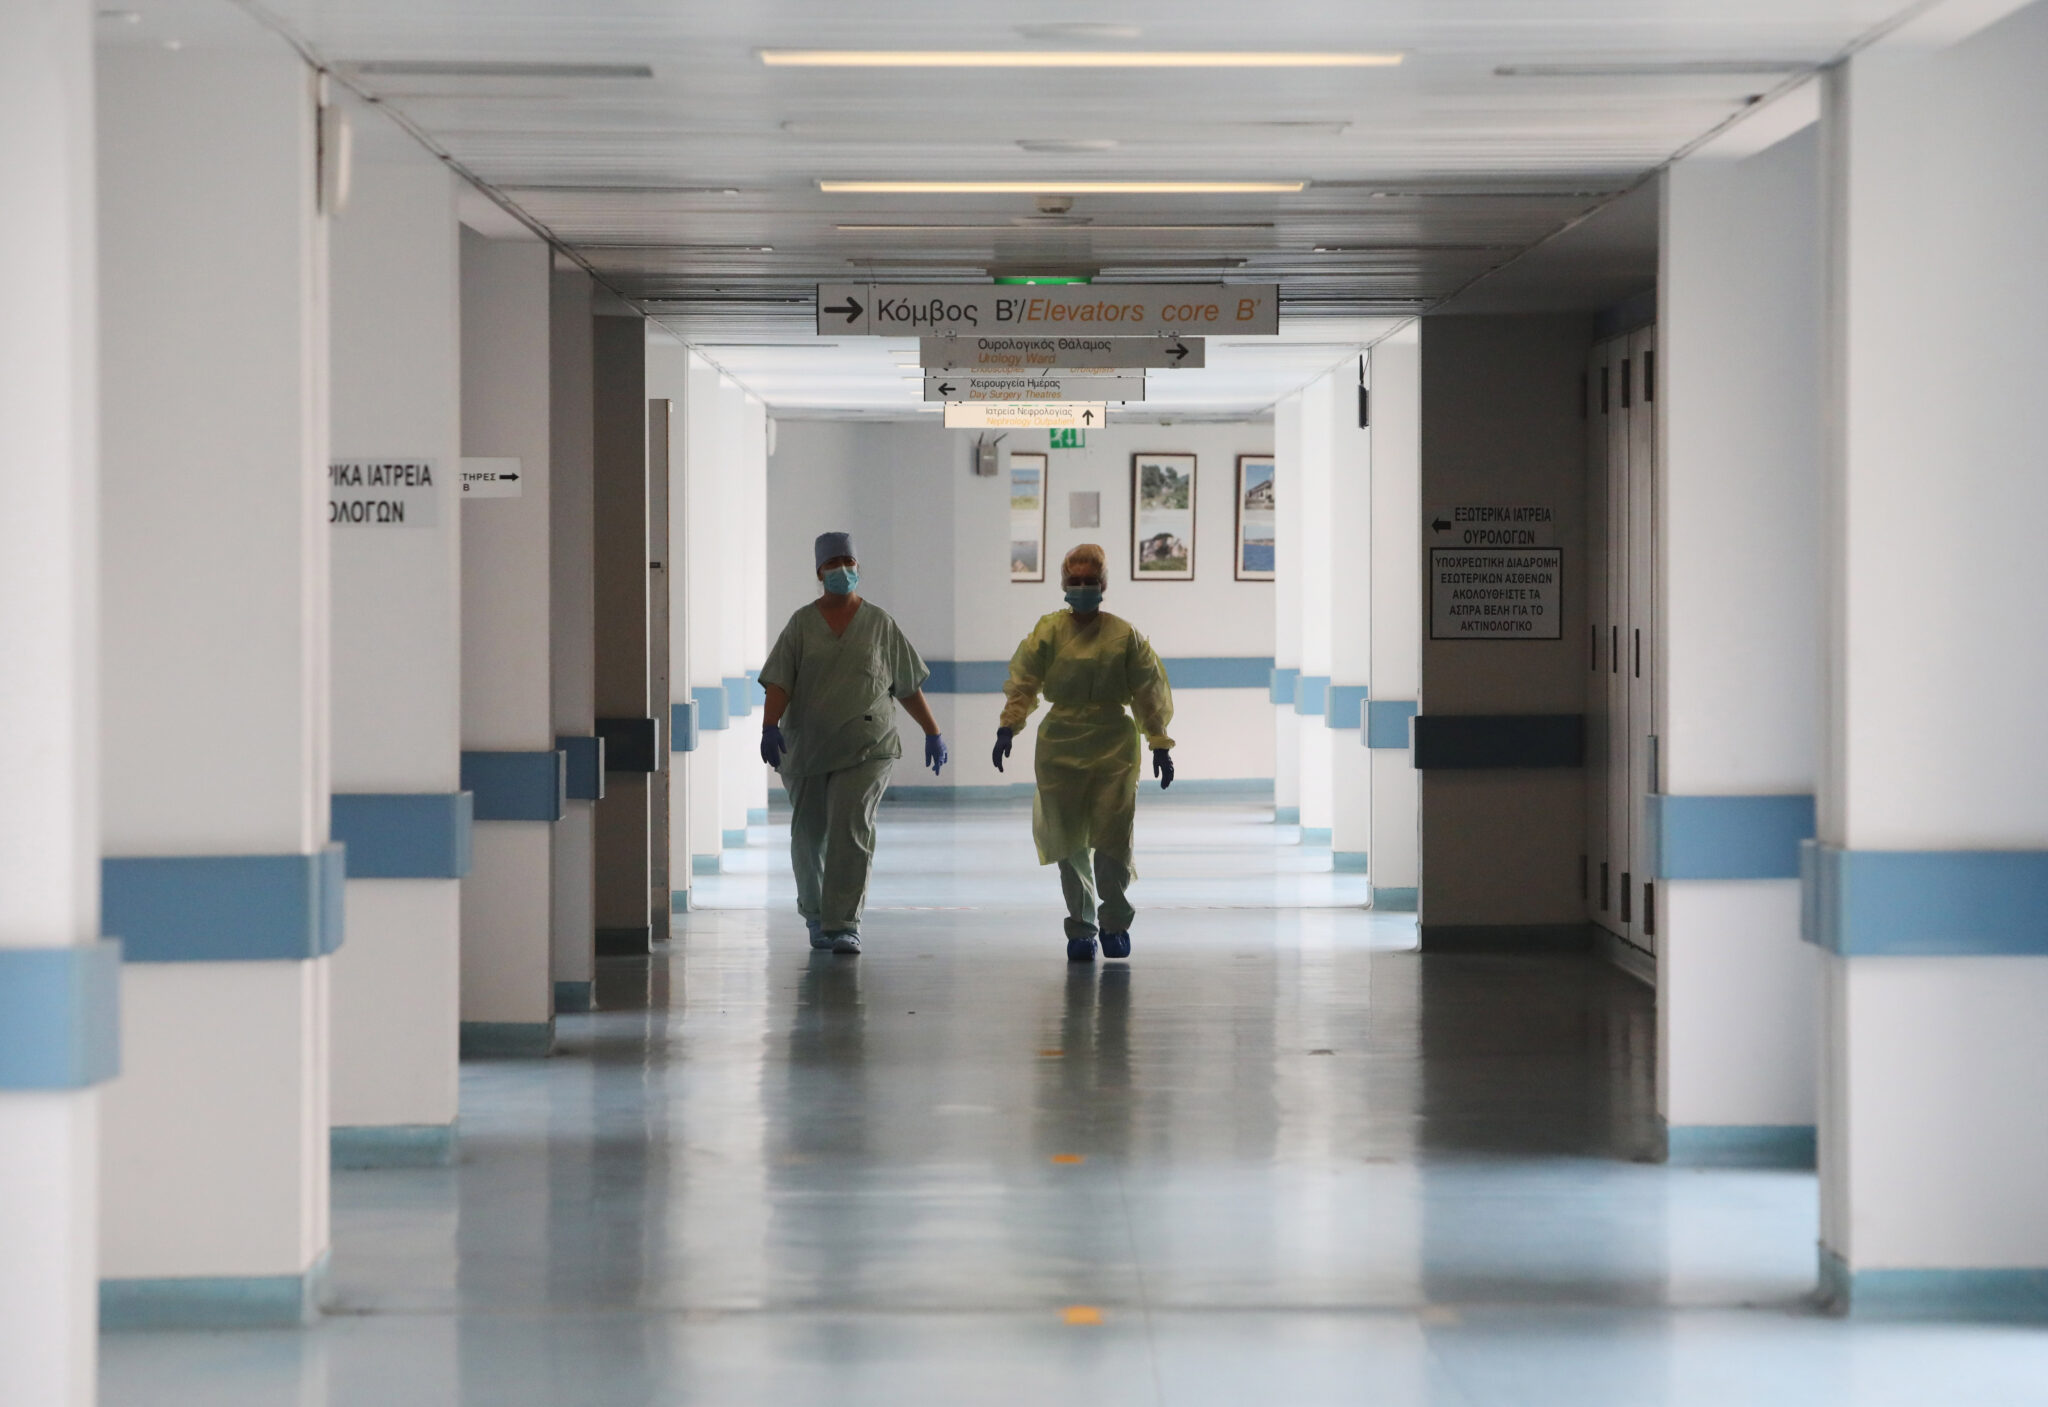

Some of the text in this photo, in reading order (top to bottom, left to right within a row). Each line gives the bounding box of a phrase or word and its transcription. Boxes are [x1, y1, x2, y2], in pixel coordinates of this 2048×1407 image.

[878, 298, 978, 327] Κόμβος
[1161, 303, 1220, 322] core
[978, 338, 1112, 352] Ουρολογικός Θάλαμος
[978, 352, 1057, 366] Urology Ward
[970, 378, 1061, 389] Χειρουργεία Ημέρας
[969, 390, 1062, 400] Day Surgery Theatres
[985, 407, 1015, 416] Ιατρεία
[367, 464, 433, 487] ΙΑΤΡΕΙΑ
[1455, 507, 1552, 522] ΕΞΩΤΕΡΙΚΑ ΙΑΤΡΕΙΑ
[1463, 530, 1535, 544] ΟΥΡΟΛΟΓΩΝ
[1435, 557, 1558, 568] ΥΠΟΧΡΕΩΤΙΚΗ ΔΙΑΔΡΟΜΗ
[1440, 573, 1552, 584] ΕΣΩΤΕΡΙΚΩΝ ΑΣΘΕΝΩΝ
[1528, 589, 1541, 600] ΤΑ
[1449, 605, 1544, 616] ΑΣΠΡΑ ΒΕΛΗ ΓΙΑ ΤΟ
[1460, 621, 1533, 632] ΑΚΤΙΝΟΛΟΓΙΚΟ
